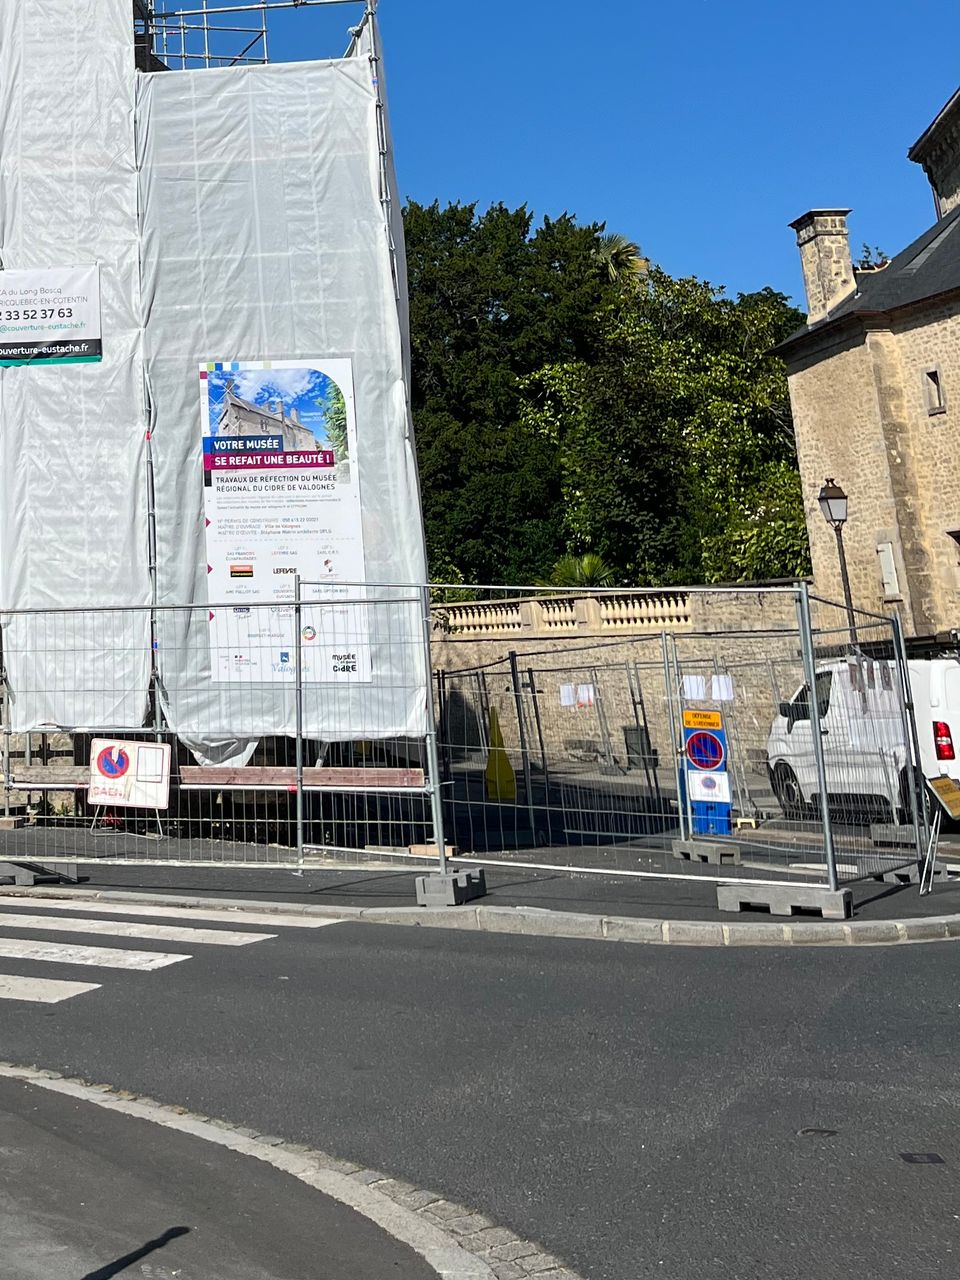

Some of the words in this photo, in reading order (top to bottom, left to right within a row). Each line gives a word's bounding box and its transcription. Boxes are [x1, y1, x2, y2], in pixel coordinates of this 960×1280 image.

[8, 288, 18, 296] du
[20, 288, 38, 297] Long
[5, 310, 20, 321] 33
[23, 309, 37, 320] 52
[40, 308, 55, 319] 37
[57, 307, 73, 318] 63
[213, 439, 244, 450] VOTRE
[246, 437, 279, 449] MUSÉE
[214, 456, 227, 466] SE
[229, 455, 261, 465] REFAIT
[264, 455, 284, 464] UNE
[286, 452, 323, 464] BEAUTÉ
[326, 454, 330, 464] !
[260, 474, 299, 483] RÉFECTION
[312, 473, 337, 481] MUSÉE
[216, 484, 251, 492] RÉGIONAL
[299, 483, 335, 491] VALOGNES
